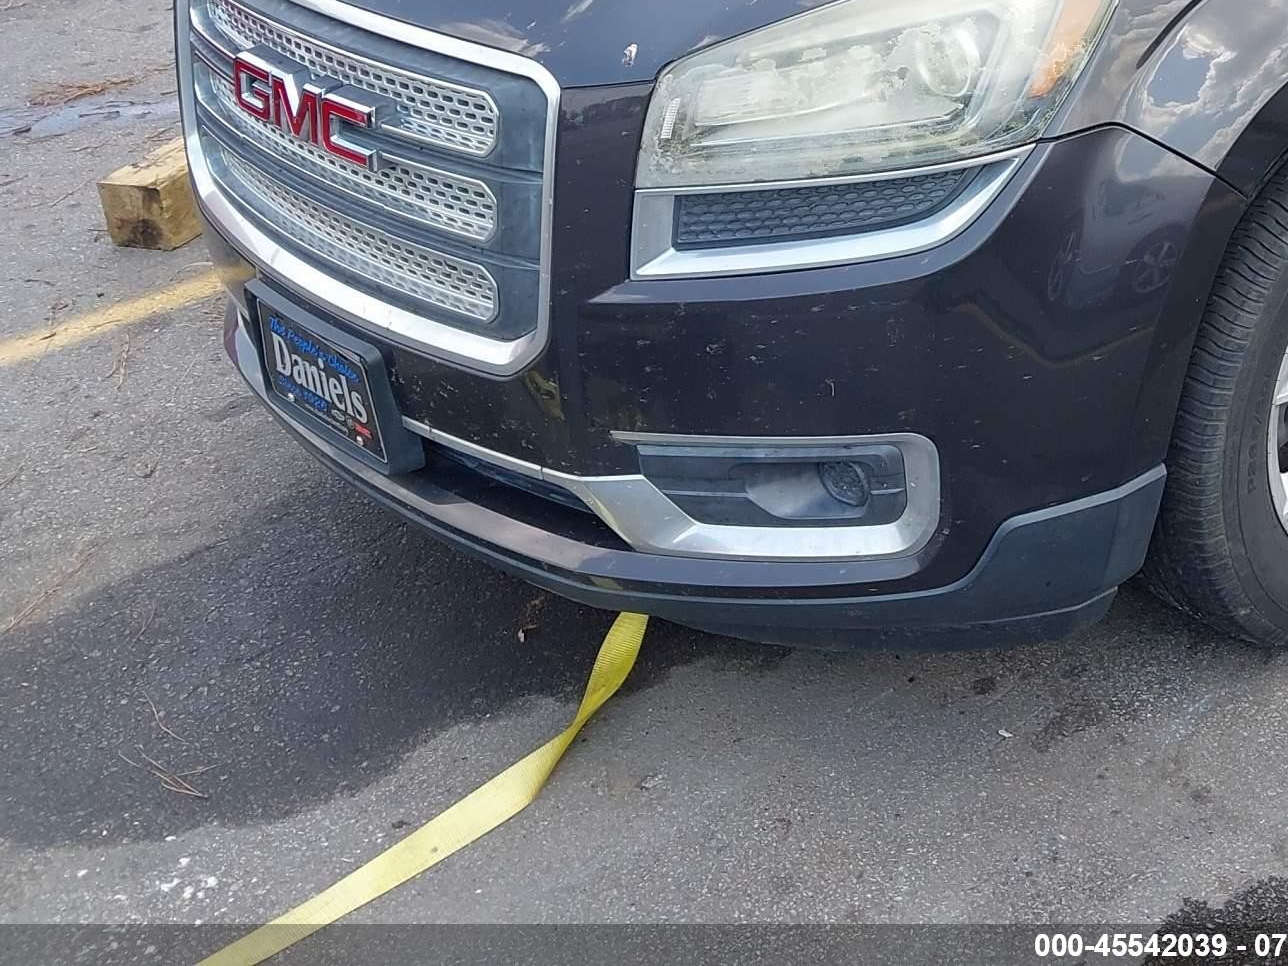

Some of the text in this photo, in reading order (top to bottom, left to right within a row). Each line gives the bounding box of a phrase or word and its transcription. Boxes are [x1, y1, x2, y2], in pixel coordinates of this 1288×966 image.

[234, 52, 376, 172] GMC
[269, 316, 286, 335] The
[271, 332, 367, 423] Daniels
